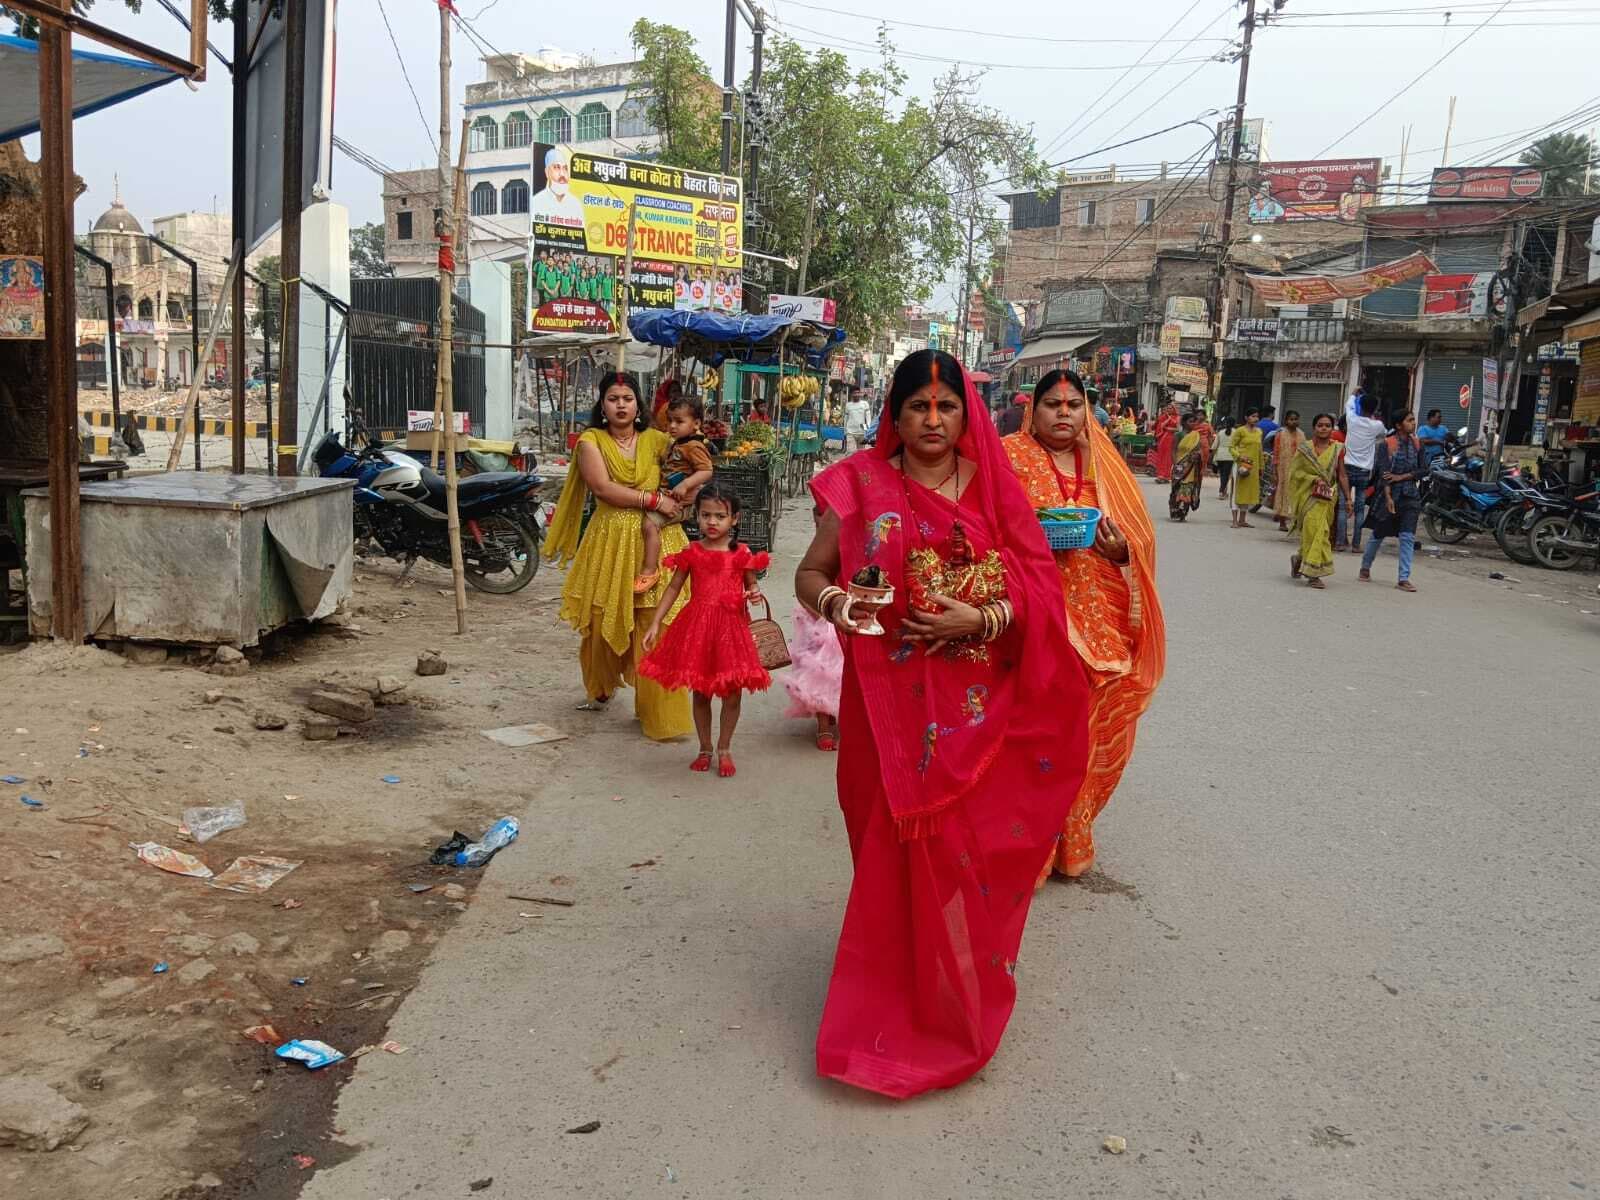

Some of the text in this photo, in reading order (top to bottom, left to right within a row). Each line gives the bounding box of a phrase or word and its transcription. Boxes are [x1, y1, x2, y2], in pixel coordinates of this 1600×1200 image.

[573, 158, 592, 173] अब
[593, 161, 628, 182] मधुबनी
[630, 167, 648, 183] बना
[649, 168, 671, 187] कोटा
[673, 171, 682, 189] से
[683, 172, 707, 193] बेहतर
